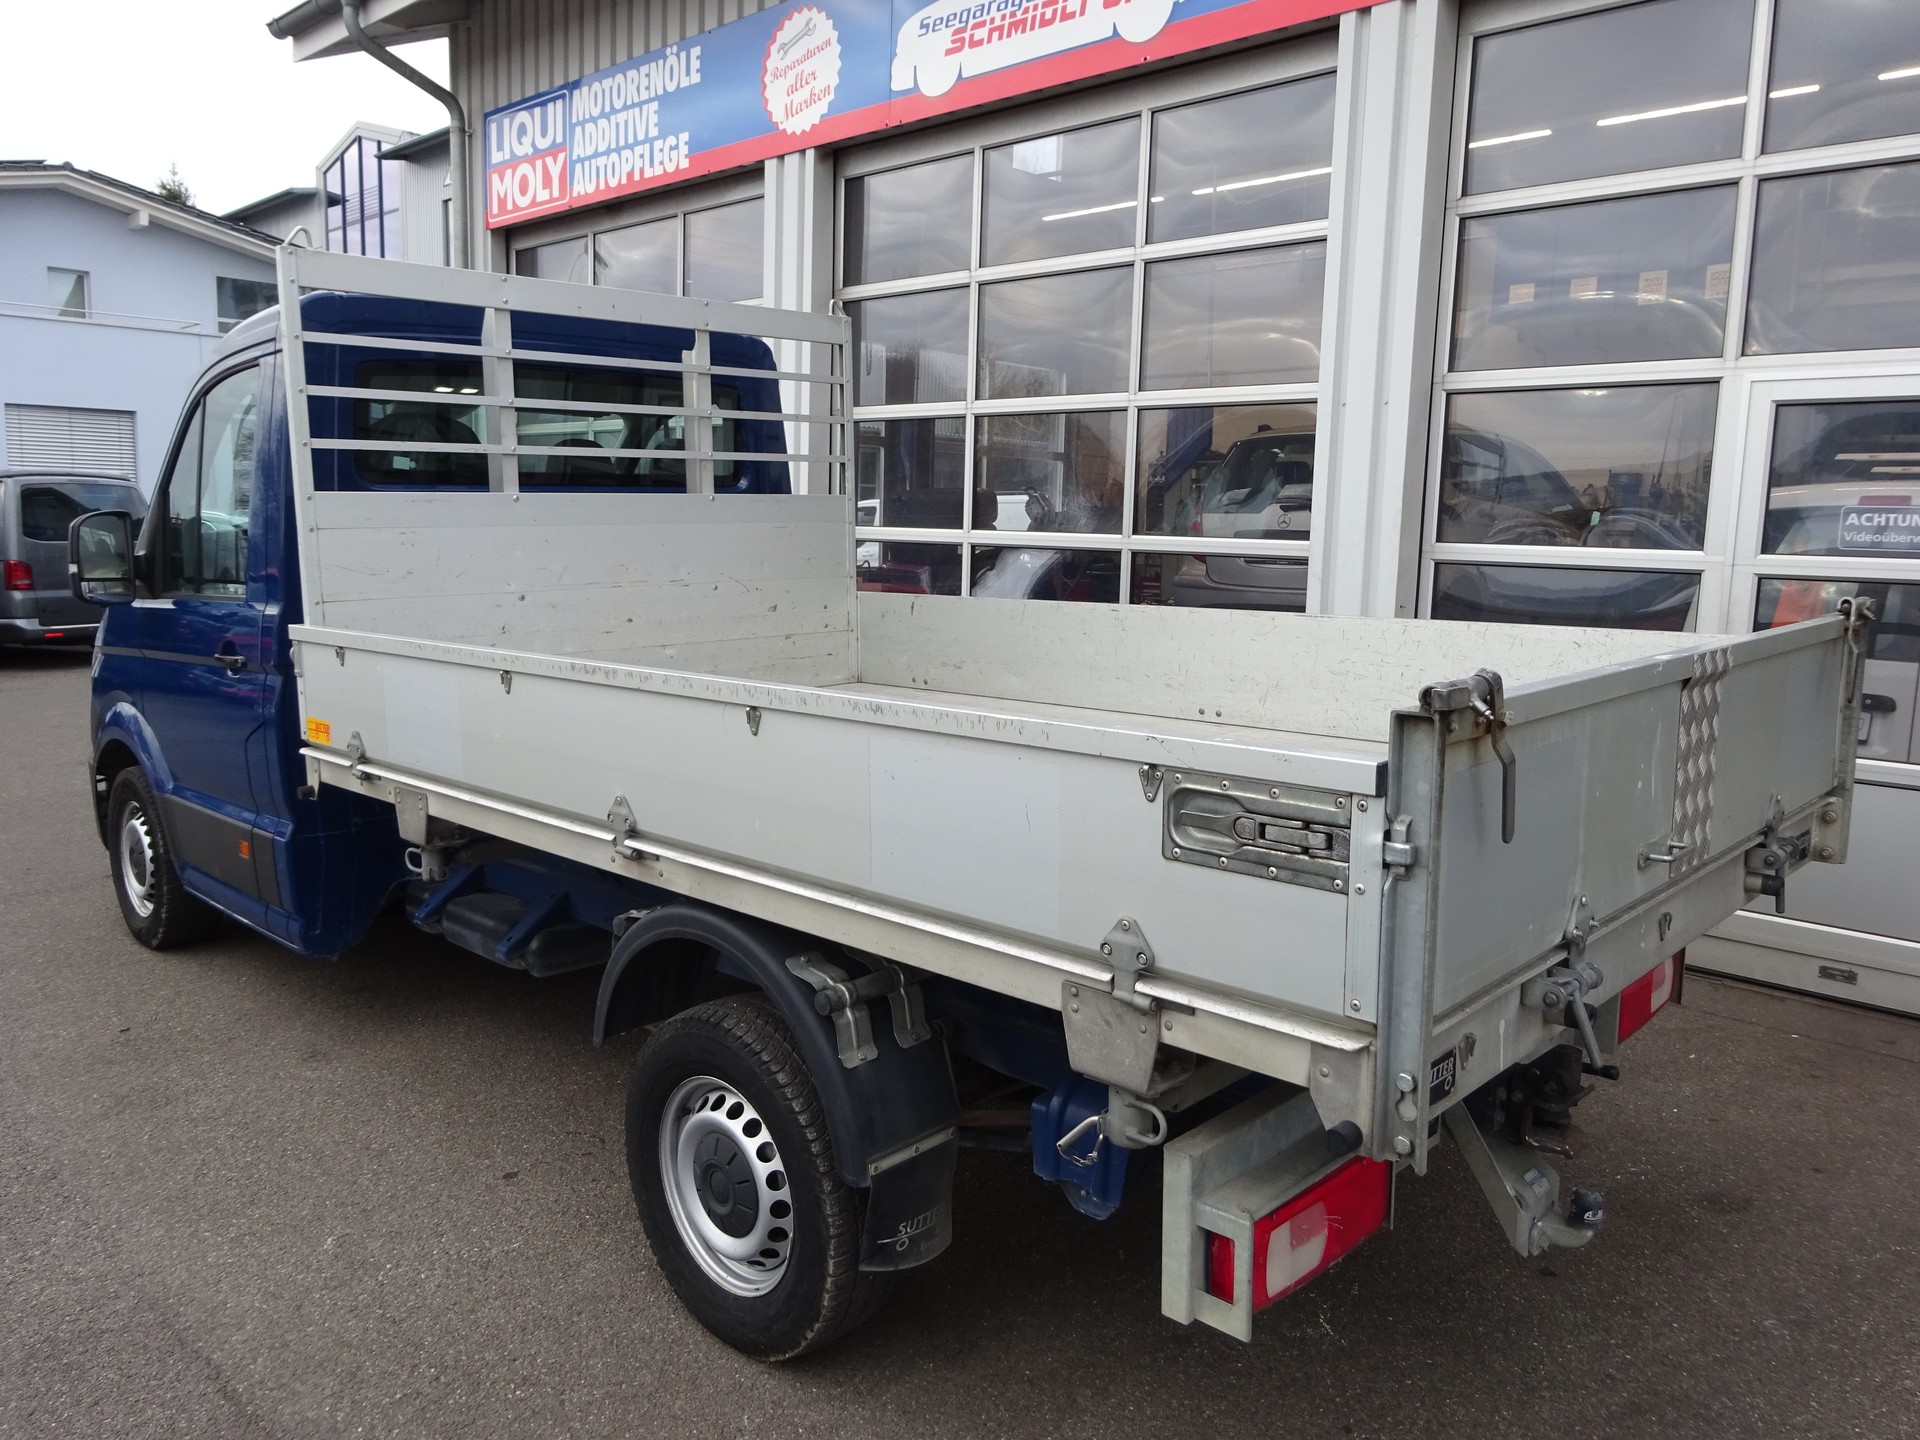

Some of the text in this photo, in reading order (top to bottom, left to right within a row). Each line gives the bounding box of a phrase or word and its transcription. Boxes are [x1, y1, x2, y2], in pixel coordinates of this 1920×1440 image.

[918, 0, 1037, 38] Seegarag
[572, 45, 701, 123] MOTORENÖLE
[770, 38, 832, 83] Reparaturen
[786, 69, 818, 97] aller
[780, 84, 832, 124] Marken
[490, 99, 564, 164] LIQUI
[572, 101, 659, 160] ADDITIVE
[491, 152, 566, 215] MOLY
[572, 131, 690, 197] AUTOPFLEGE
[1430, 1057, 1454, 1083] TTER
